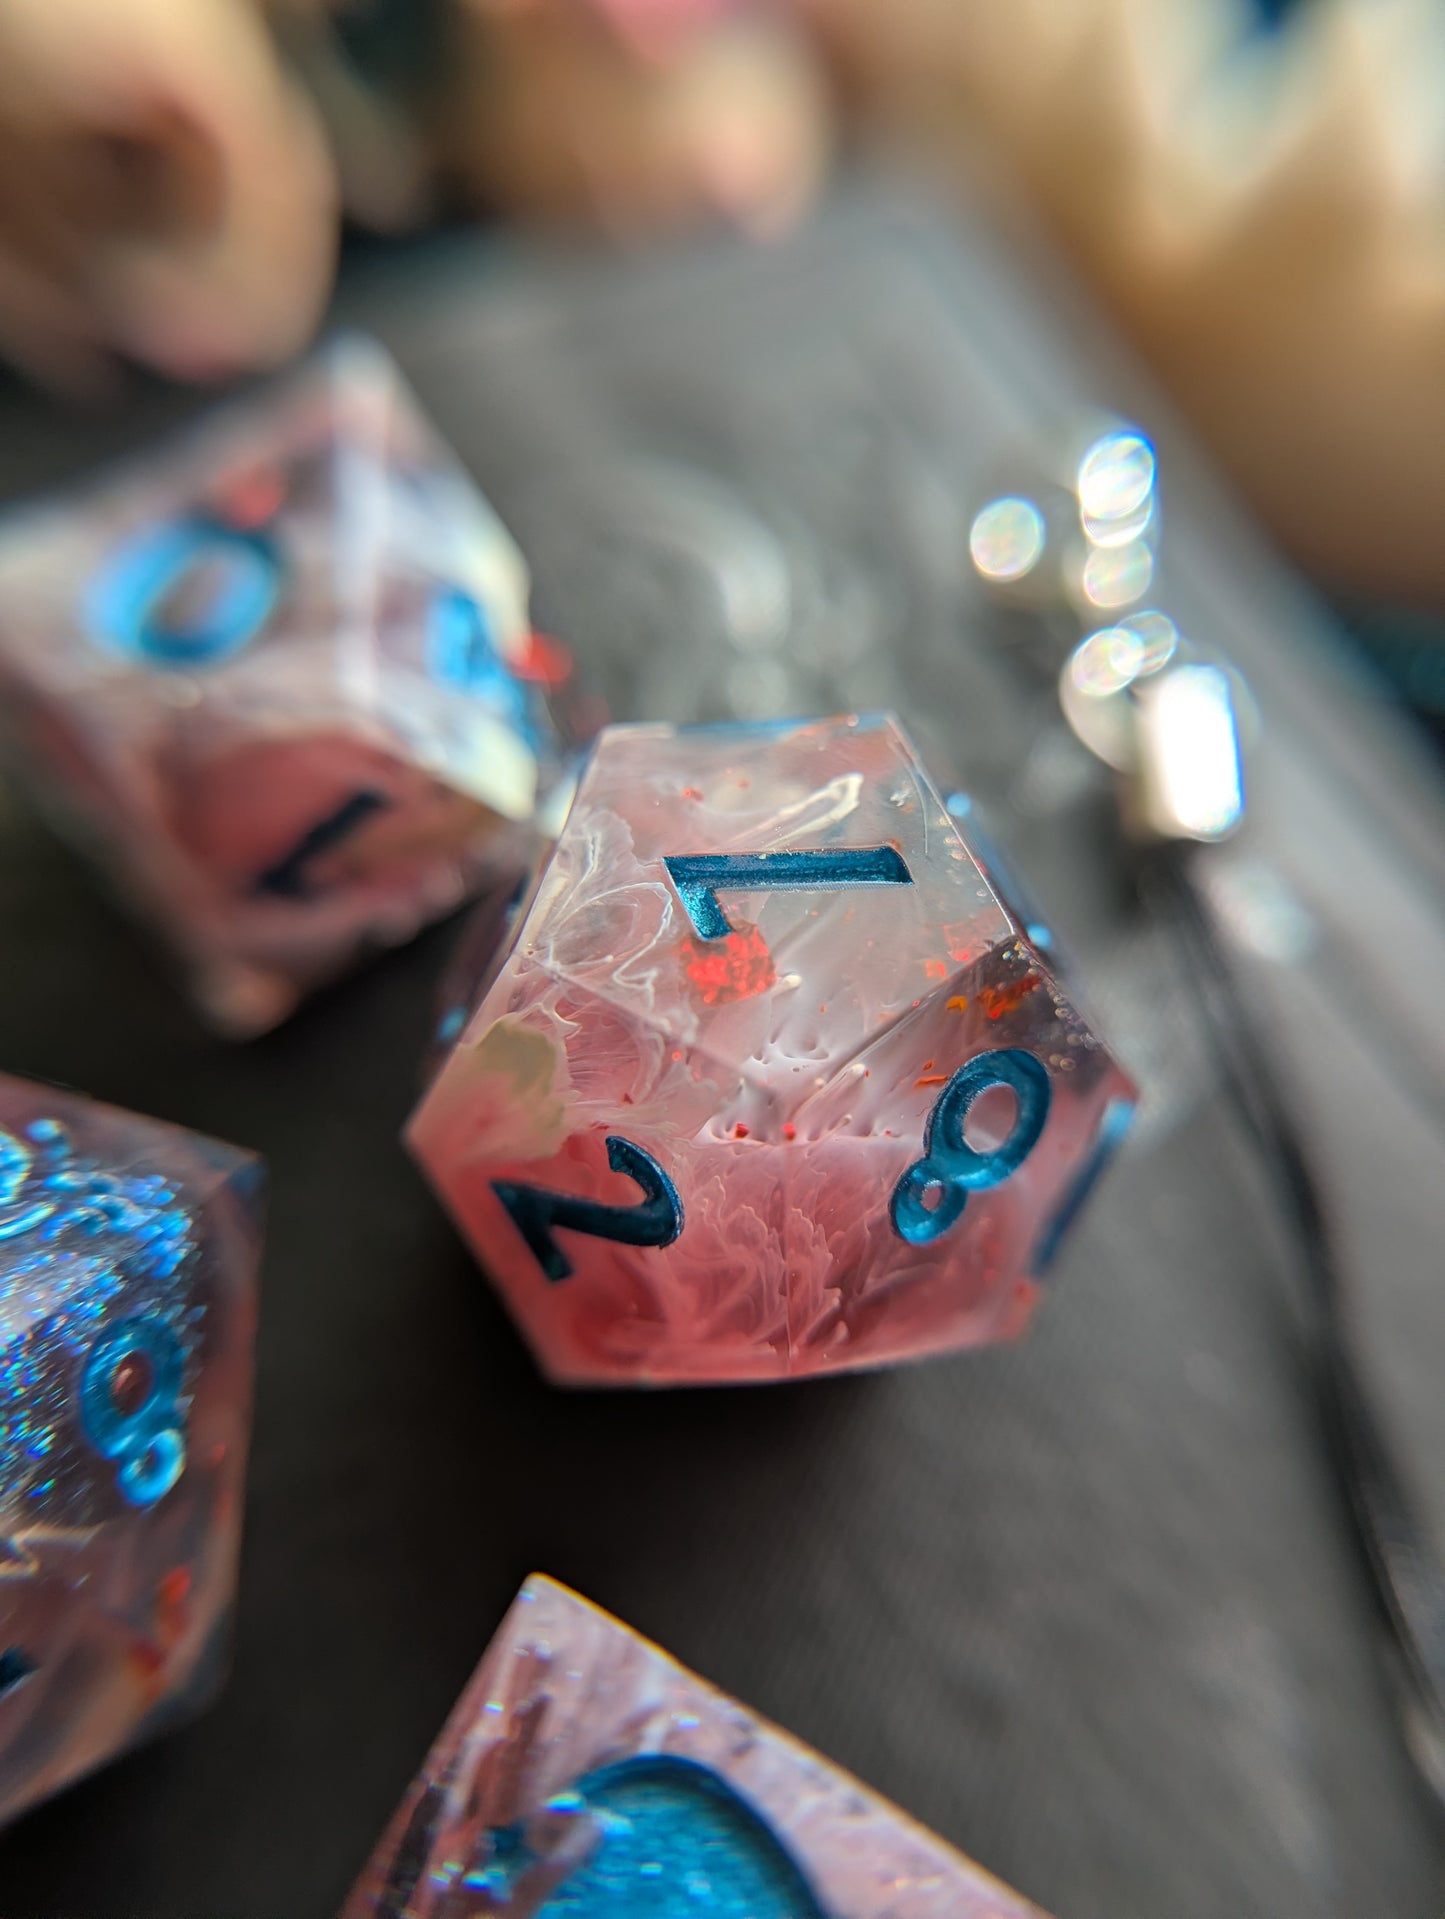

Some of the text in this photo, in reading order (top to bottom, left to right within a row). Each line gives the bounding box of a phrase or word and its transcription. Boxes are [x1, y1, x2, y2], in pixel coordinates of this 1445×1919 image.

[490, 1135, 686, 1283] 2
[890, 1048, 1053, 1245] 8
[80, 1313, 187, 1506] 8
